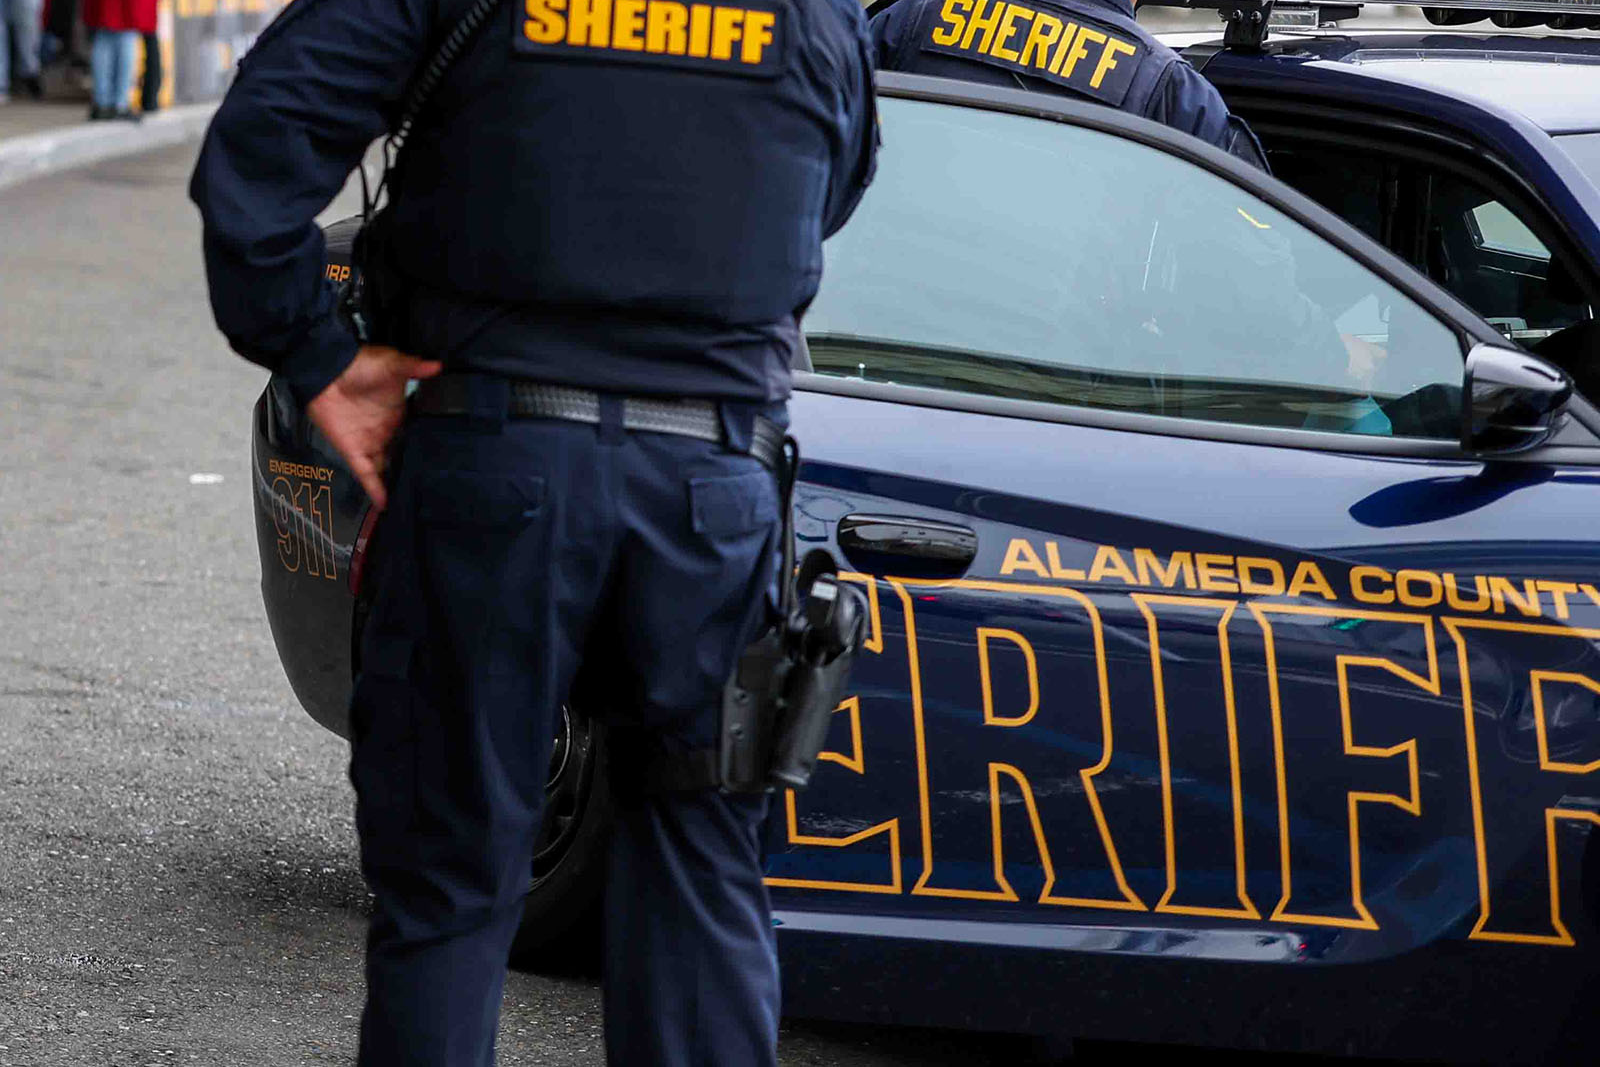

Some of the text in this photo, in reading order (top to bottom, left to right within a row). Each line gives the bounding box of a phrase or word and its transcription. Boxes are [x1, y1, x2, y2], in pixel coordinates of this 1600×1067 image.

[269, 459, 335, 483] EMERGENCY
[271, 475, 337, 581] 911
[1000, 537, 1337, 600] ALAMEDA
